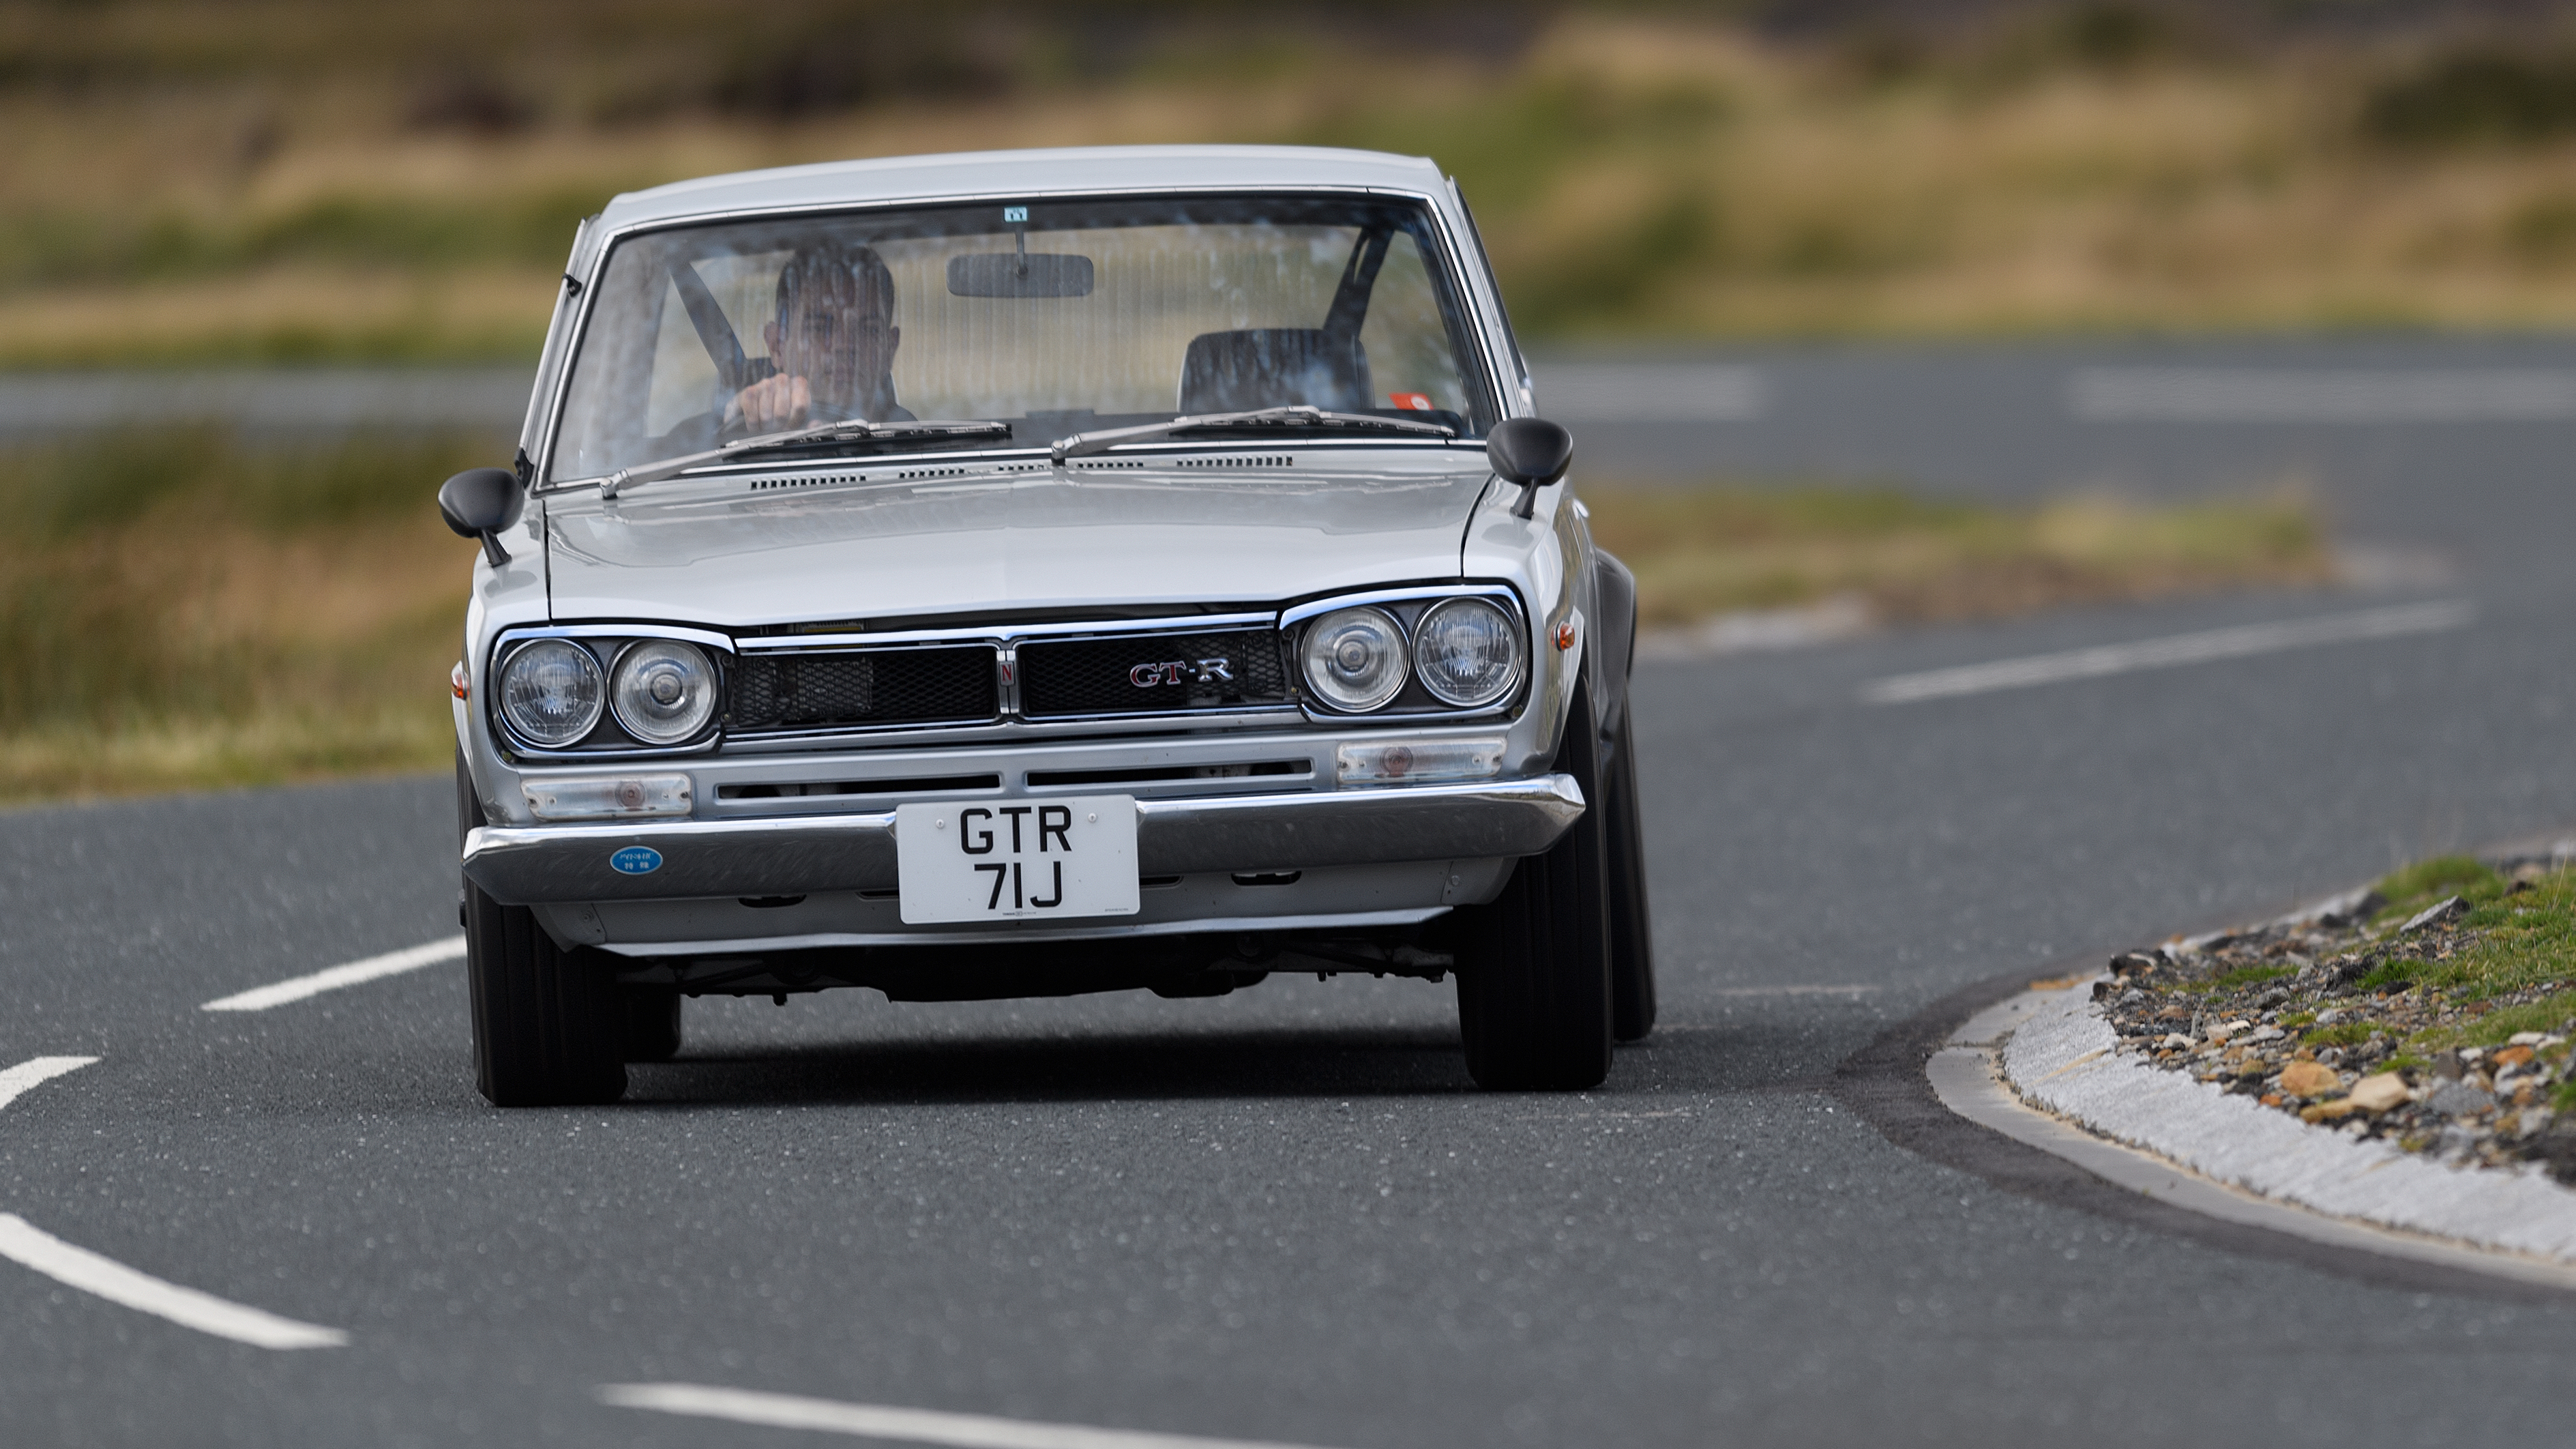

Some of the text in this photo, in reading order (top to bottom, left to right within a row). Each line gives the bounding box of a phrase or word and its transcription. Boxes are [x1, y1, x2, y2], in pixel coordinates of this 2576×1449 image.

[1001, 663, 1012, 682] N
[1129, 657, 1234, 688] GT-R
[960, 805, 1072, 855] GTR
[974, 861, 1062, 909] 71J
